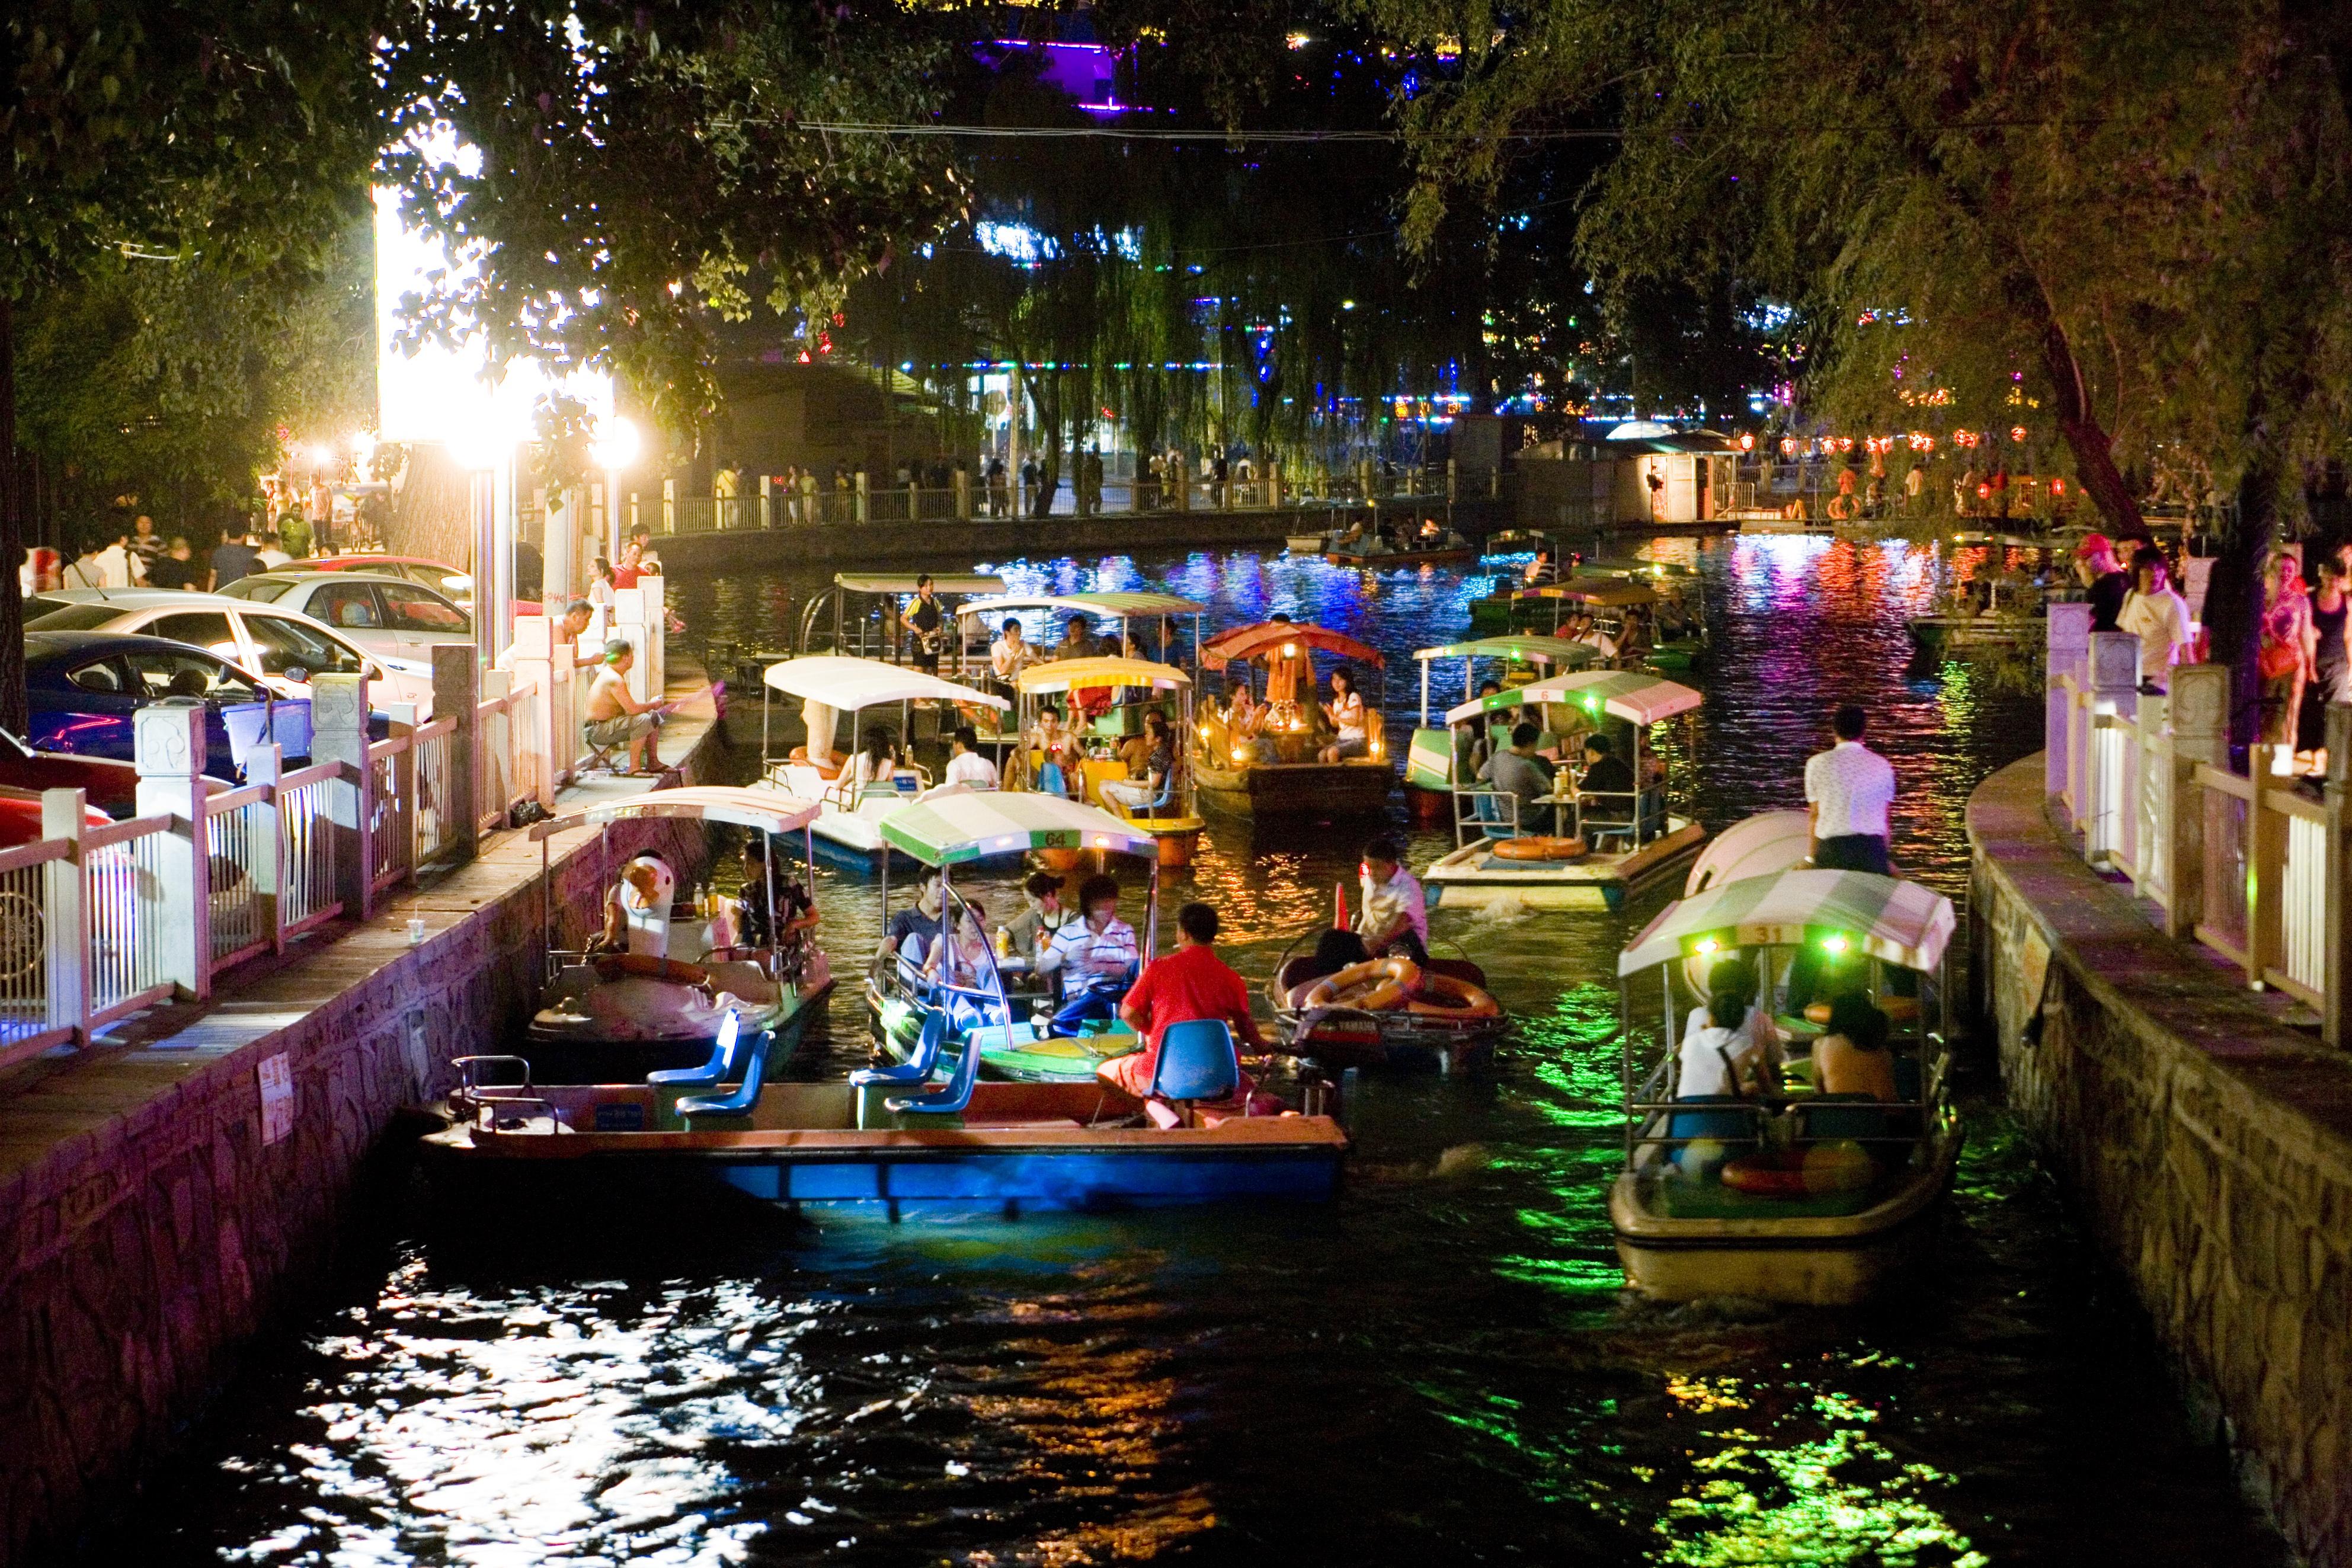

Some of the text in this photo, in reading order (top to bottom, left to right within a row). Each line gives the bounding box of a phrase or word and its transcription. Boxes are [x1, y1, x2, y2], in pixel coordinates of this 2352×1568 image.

[1541, 690, 1548, 700] 6
[1045, 832, 1065, 846] 64
[1755, 926, 1781, 943] 31
